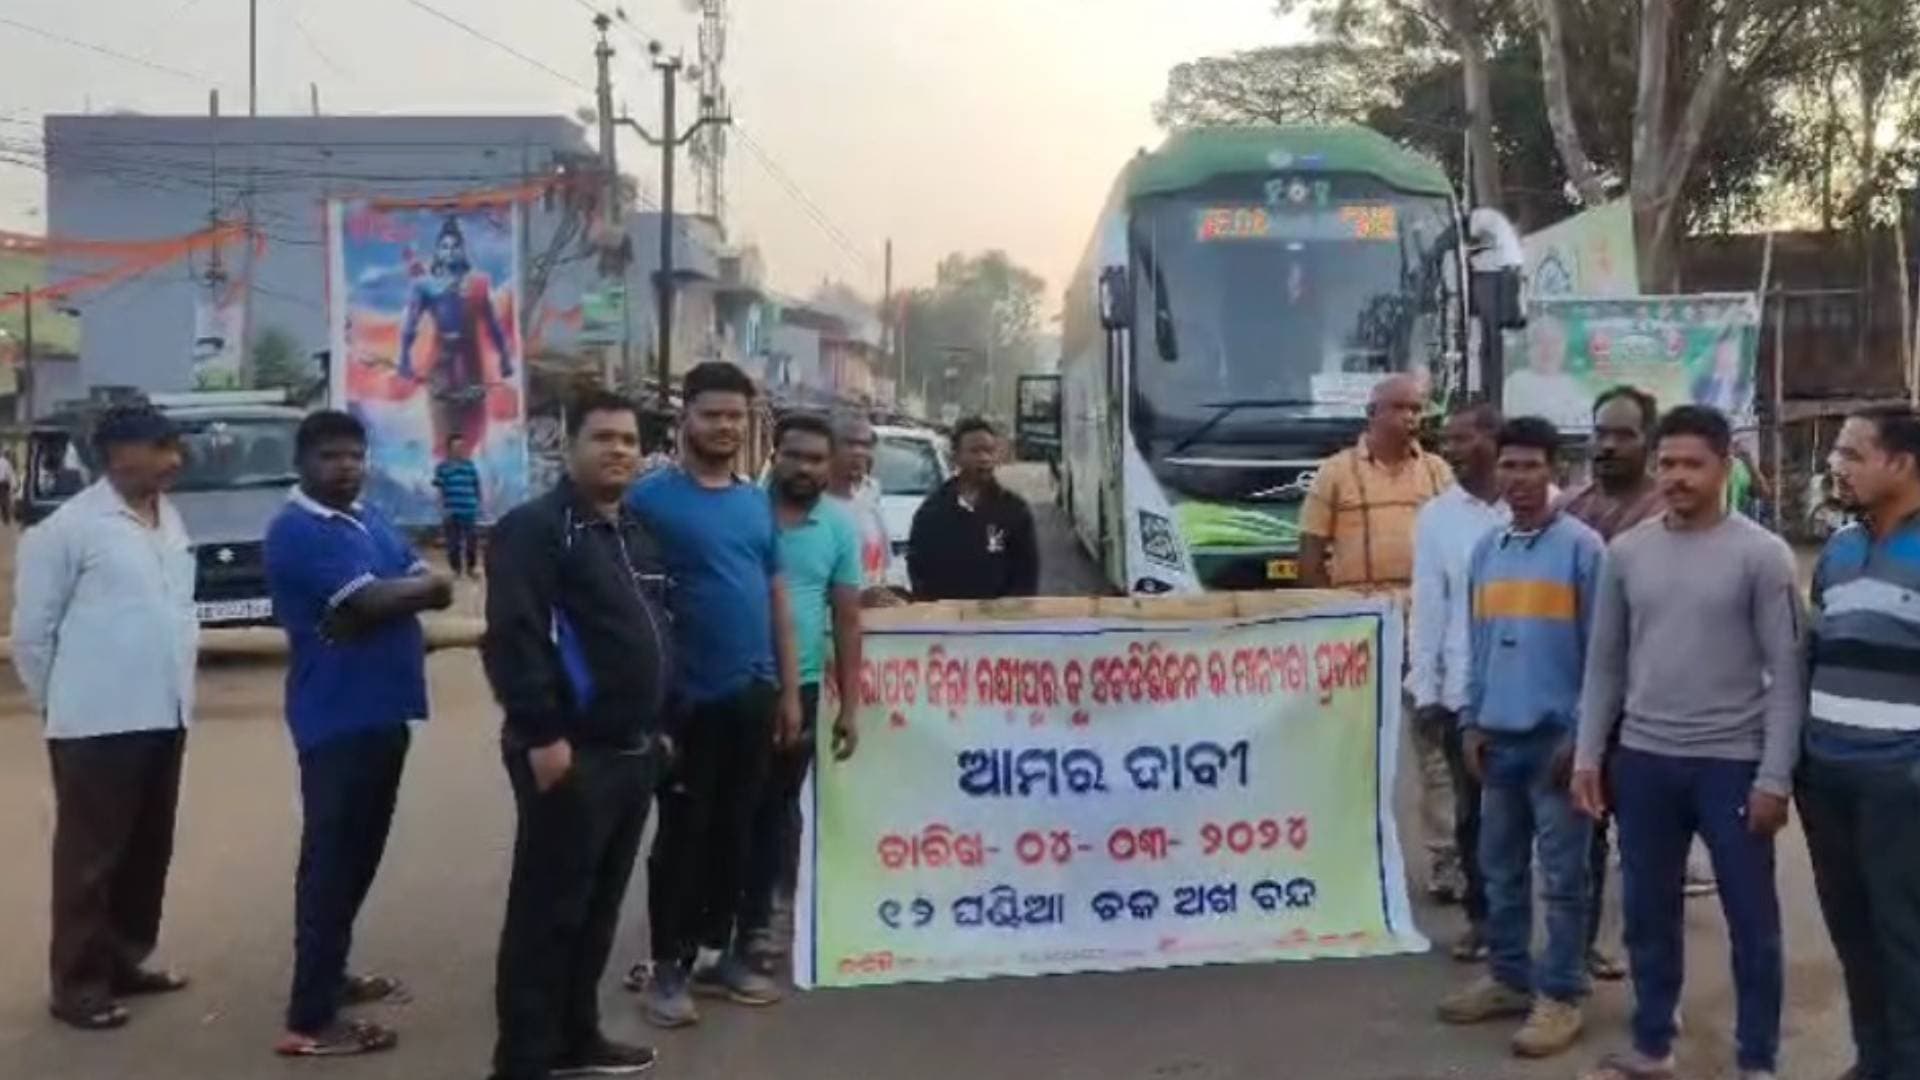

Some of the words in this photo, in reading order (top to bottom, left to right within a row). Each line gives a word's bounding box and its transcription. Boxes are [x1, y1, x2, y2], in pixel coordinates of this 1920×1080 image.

[976, 744, 1109, 796] ଆମର
[1121, 740, 1249, 788] ଦାବୀ
[1198, 817, 1308, 857] ୨୦୨୪
[1090, 889, 1160, 923] ଚକ
[1249, 876, 1316, 912] ବନ୍ଦ
